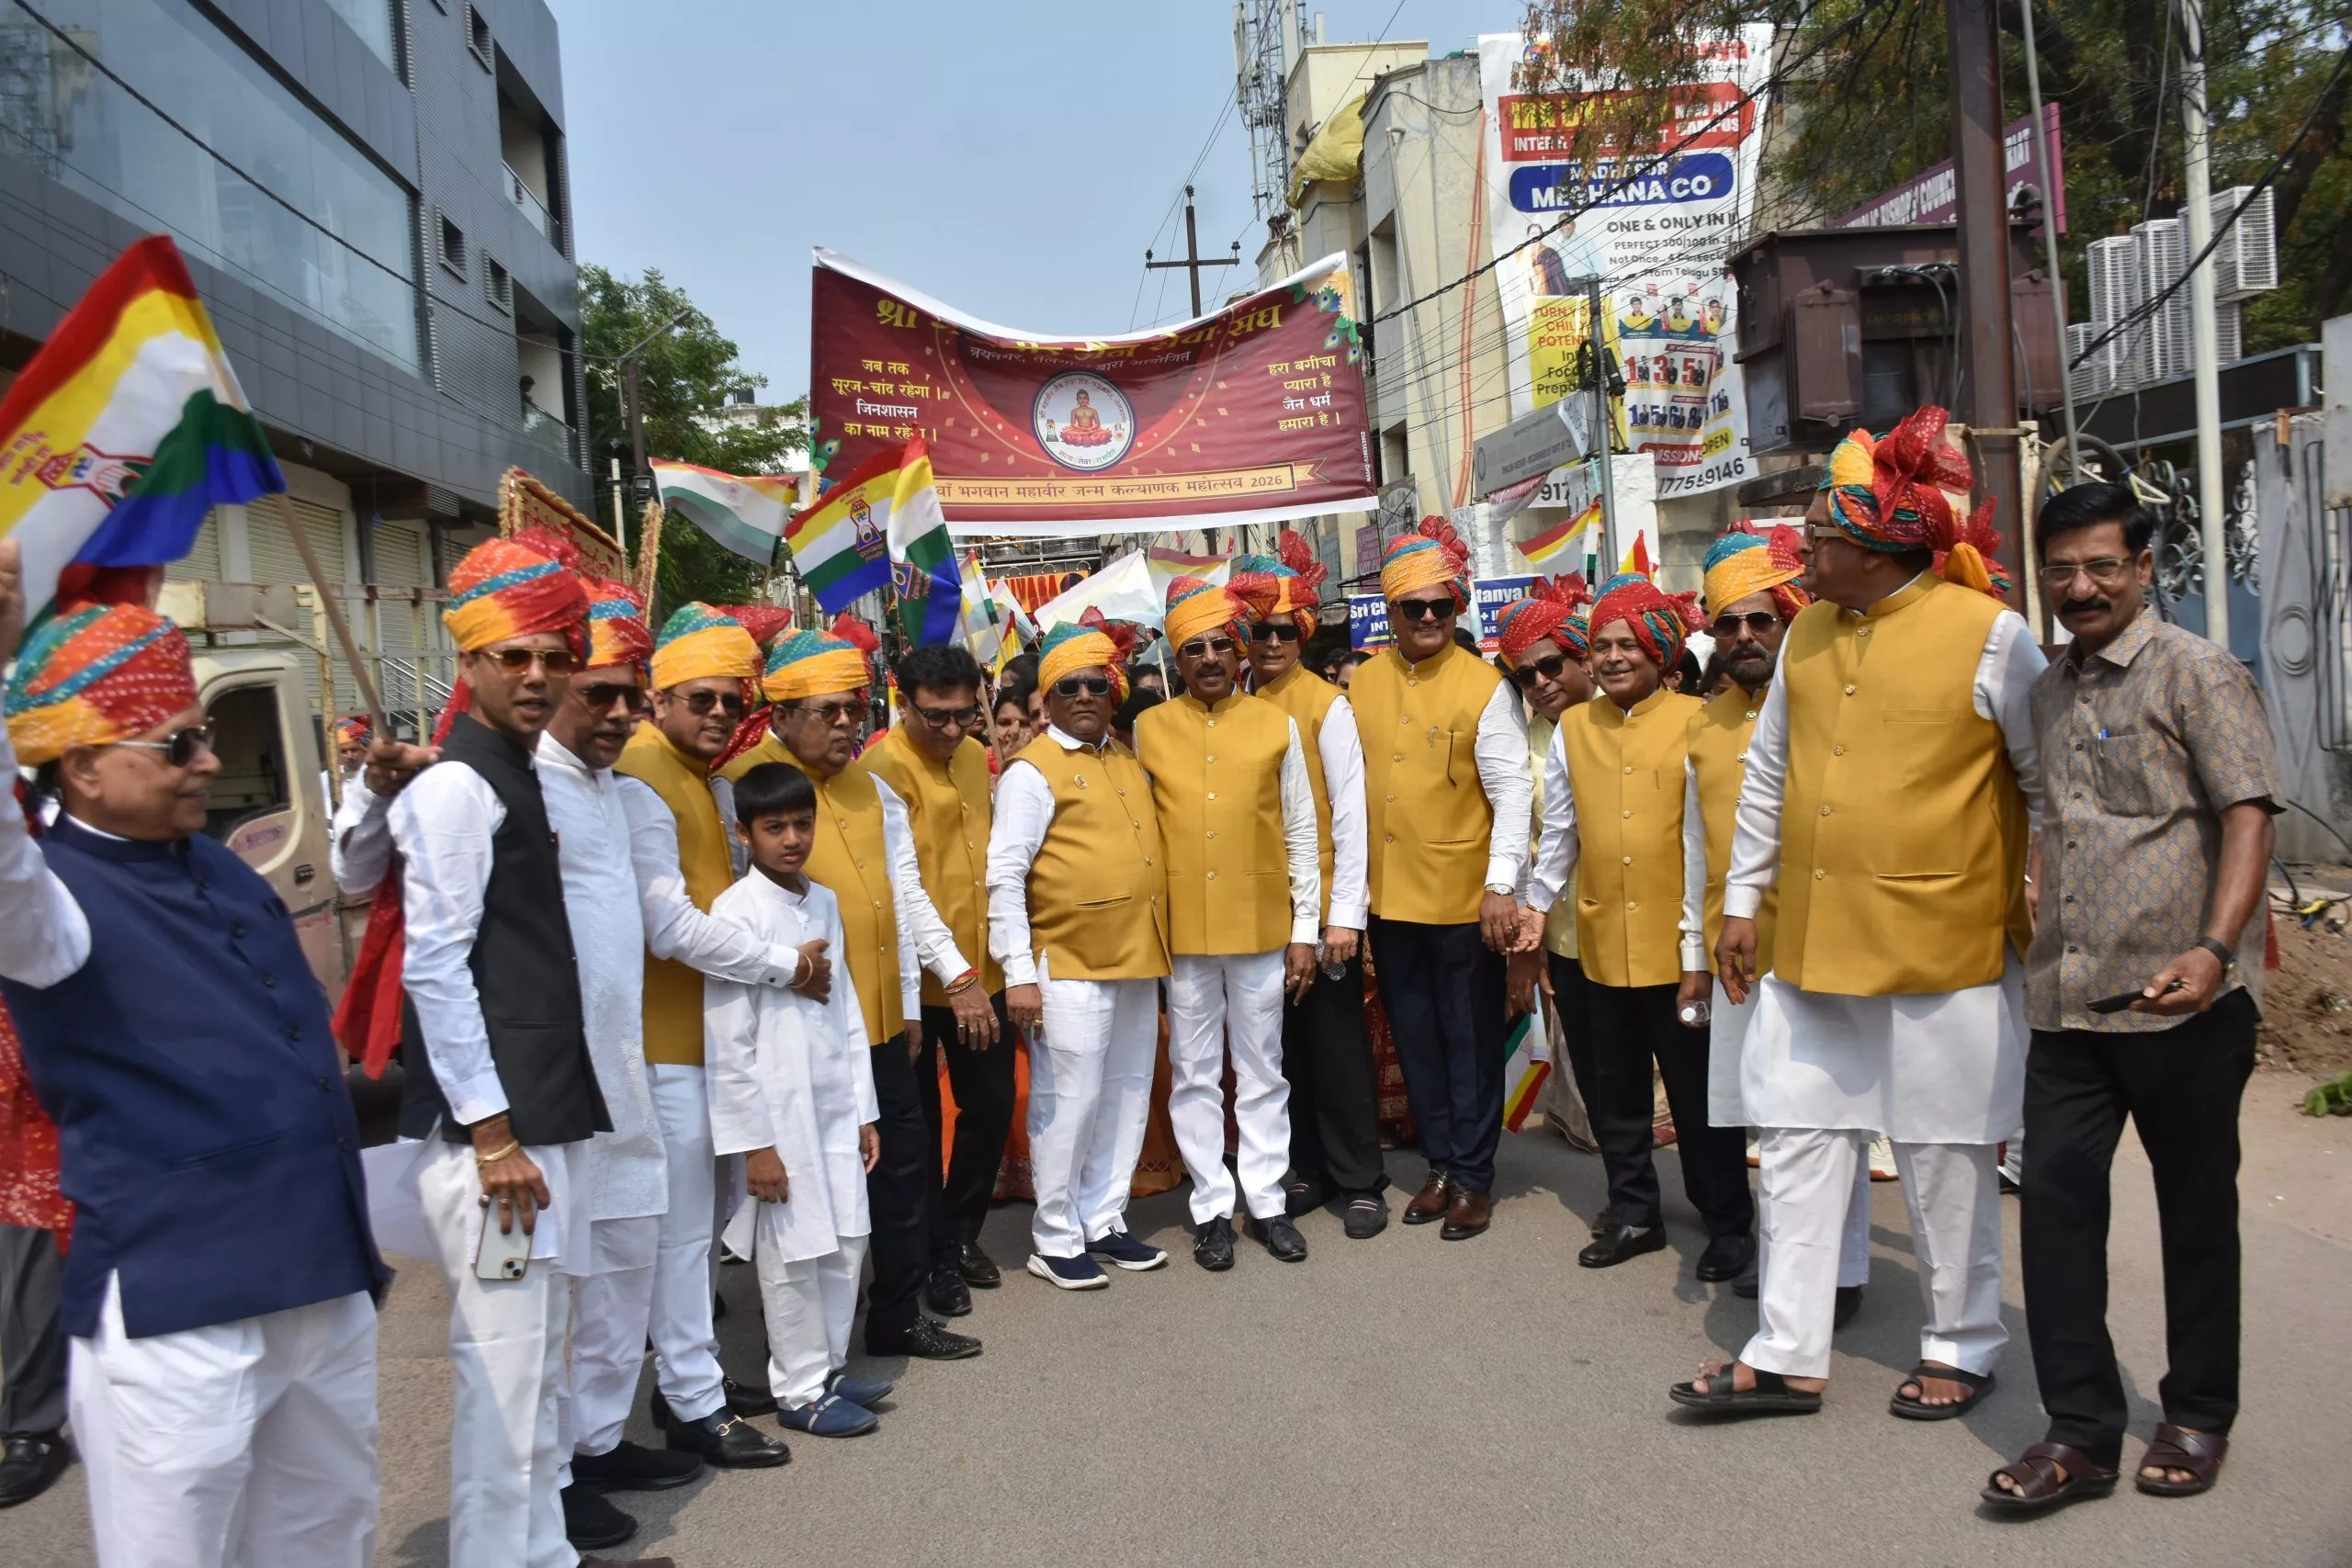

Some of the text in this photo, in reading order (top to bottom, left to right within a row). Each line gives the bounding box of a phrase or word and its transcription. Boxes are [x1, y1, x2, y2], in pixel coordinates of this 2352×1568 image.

[1670, 175, 1712, 198] CO
[1607, 220, 1640, 232] ONE
[1645, 219, 1656, 231] &
[1660, 214, 1703, 230] ONLY
[1708, 213, 1724, 226] IN
[1614, 240, 1659, 250] PERFECT
[1610, 256, 1629, 265] Not
[1676, 266, 1710, 279] Telugu
[1227, 304, 1283, 337] संघ
[1534, 306, 1567, 318] TURN
[862, 359, 910, 375] जब तक
[1268, 355, 1337, 376] हरा बगीचा
[831, 378, 895, 396] सूरज-चांद
[899, 380, 930, 398] रहेगा
[1283, 372, 1331, 391] प्यारा है
[856, 398, 918, 419] जिनशासन
[1283, 391, 1331, 411] जैन धर्म
[844, 423, 862, 436] का
[866, 424, 889, 438] नाम
[1278, 416, 1315, 432] हमारा
[1317, 411, 1329, 426] है
[1702, 432, 1729, 455] OPEN
[1078, 457, 1091, 466] सेवा
[1363, 464, 1373, 482] NAMO
[958, 486, 1009, 498] भगवान
[1016, 482, 1068, 498] महावीर
[1073, 485, 1104, 497] जन्म
[1111, 482, 1180, 495] कल्याणक
[1185, 476, 1243, 491] महोत्सव
[1250, 475, 1283, 488] 2026
[1476, 587, 1523, 604] tanya
[1350, 604, 1369, 619] Sri
